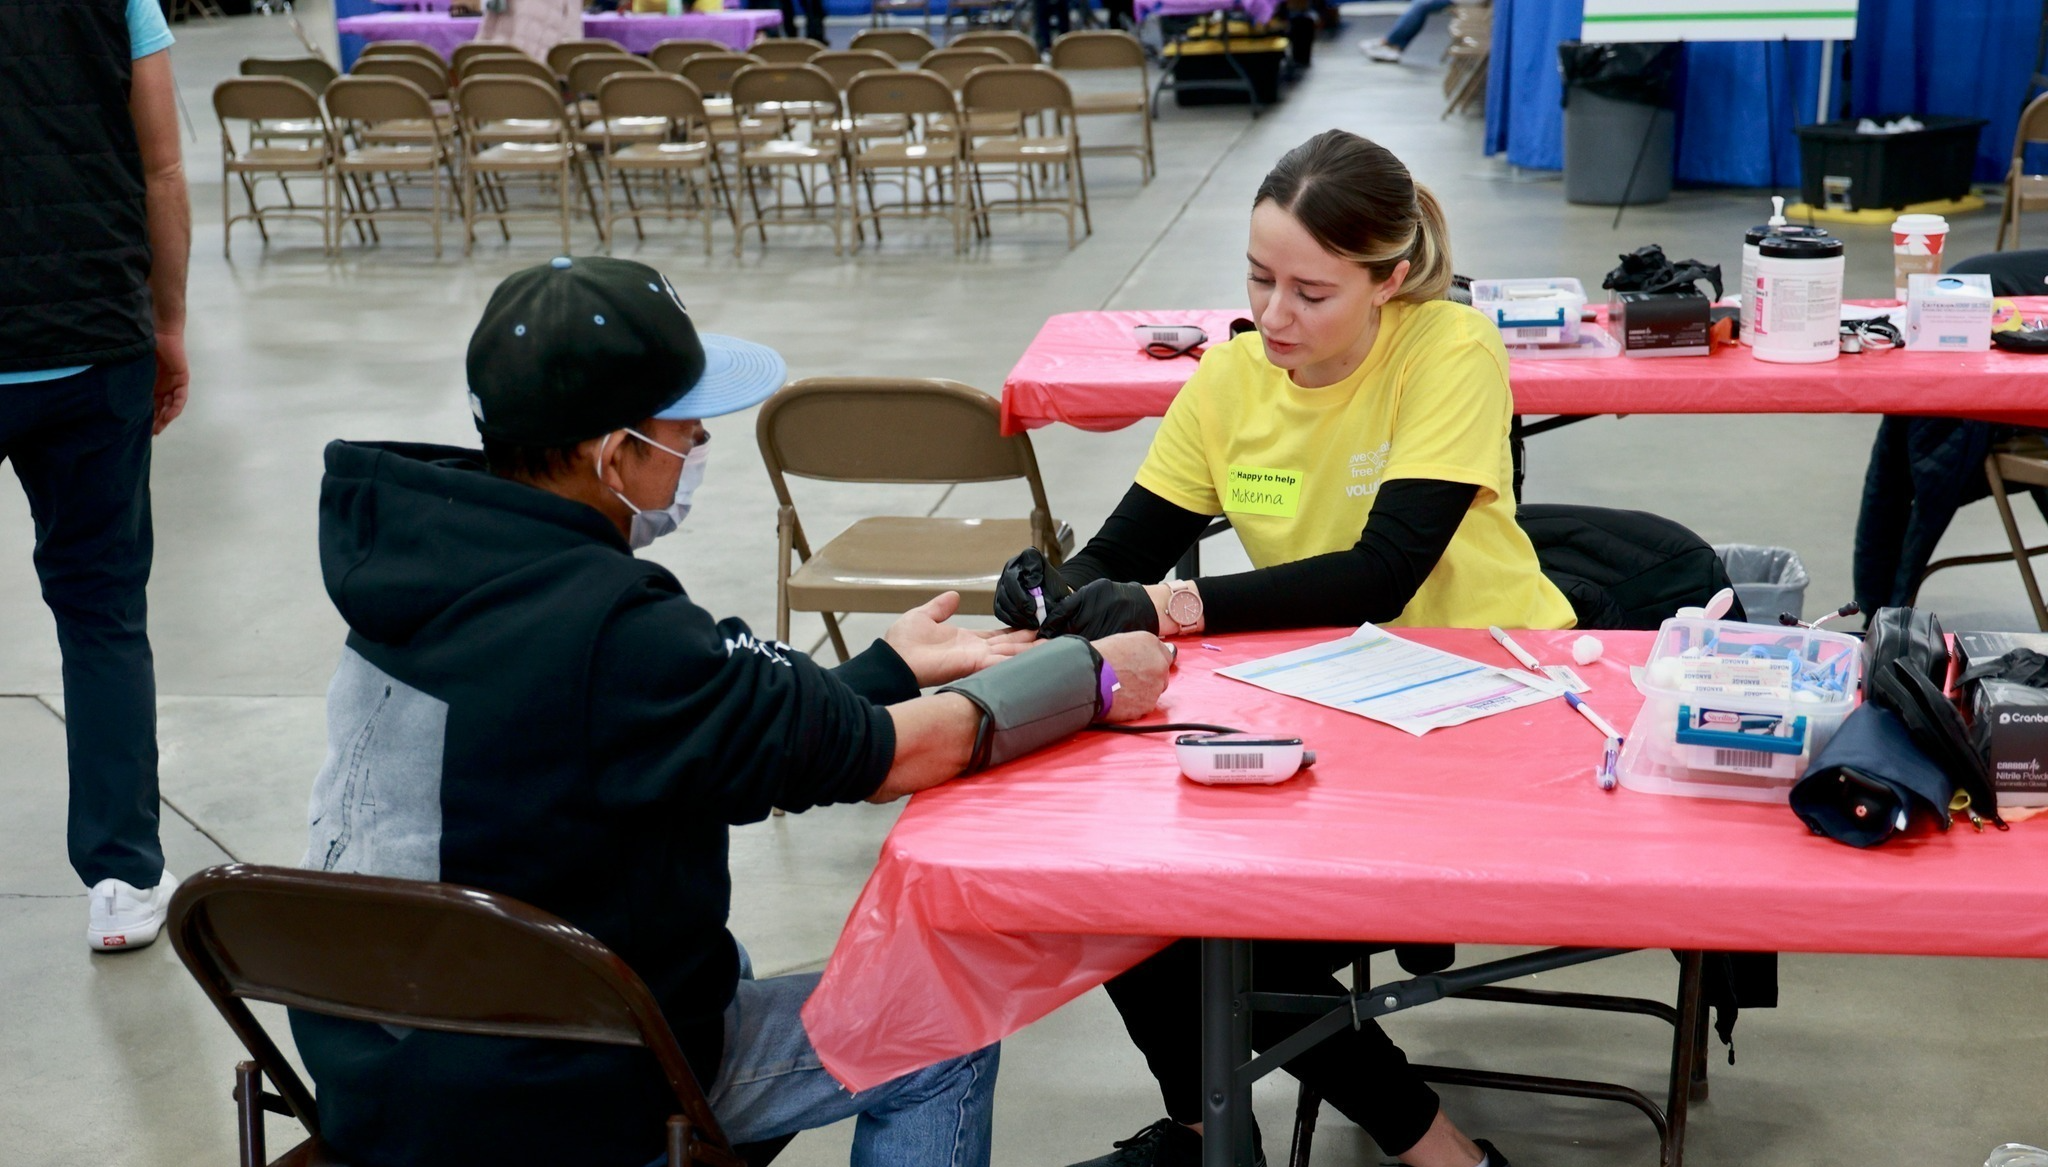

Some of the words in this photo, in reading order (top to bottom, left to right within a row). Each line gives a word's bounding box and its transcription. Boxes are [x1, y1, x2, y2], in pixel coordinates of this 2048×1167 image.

[1237, 471, 1262, 482] Happy
[1264, 474, 1273, 482] to
[1275, 474, 1296, 485] help
[1352, 467, 1373, 478] free
[1232, 488, 1284, 505] McKenna
[1996, 772, 2022, 780] Nitrile
[2023, 771, 2048, 780] Powd
